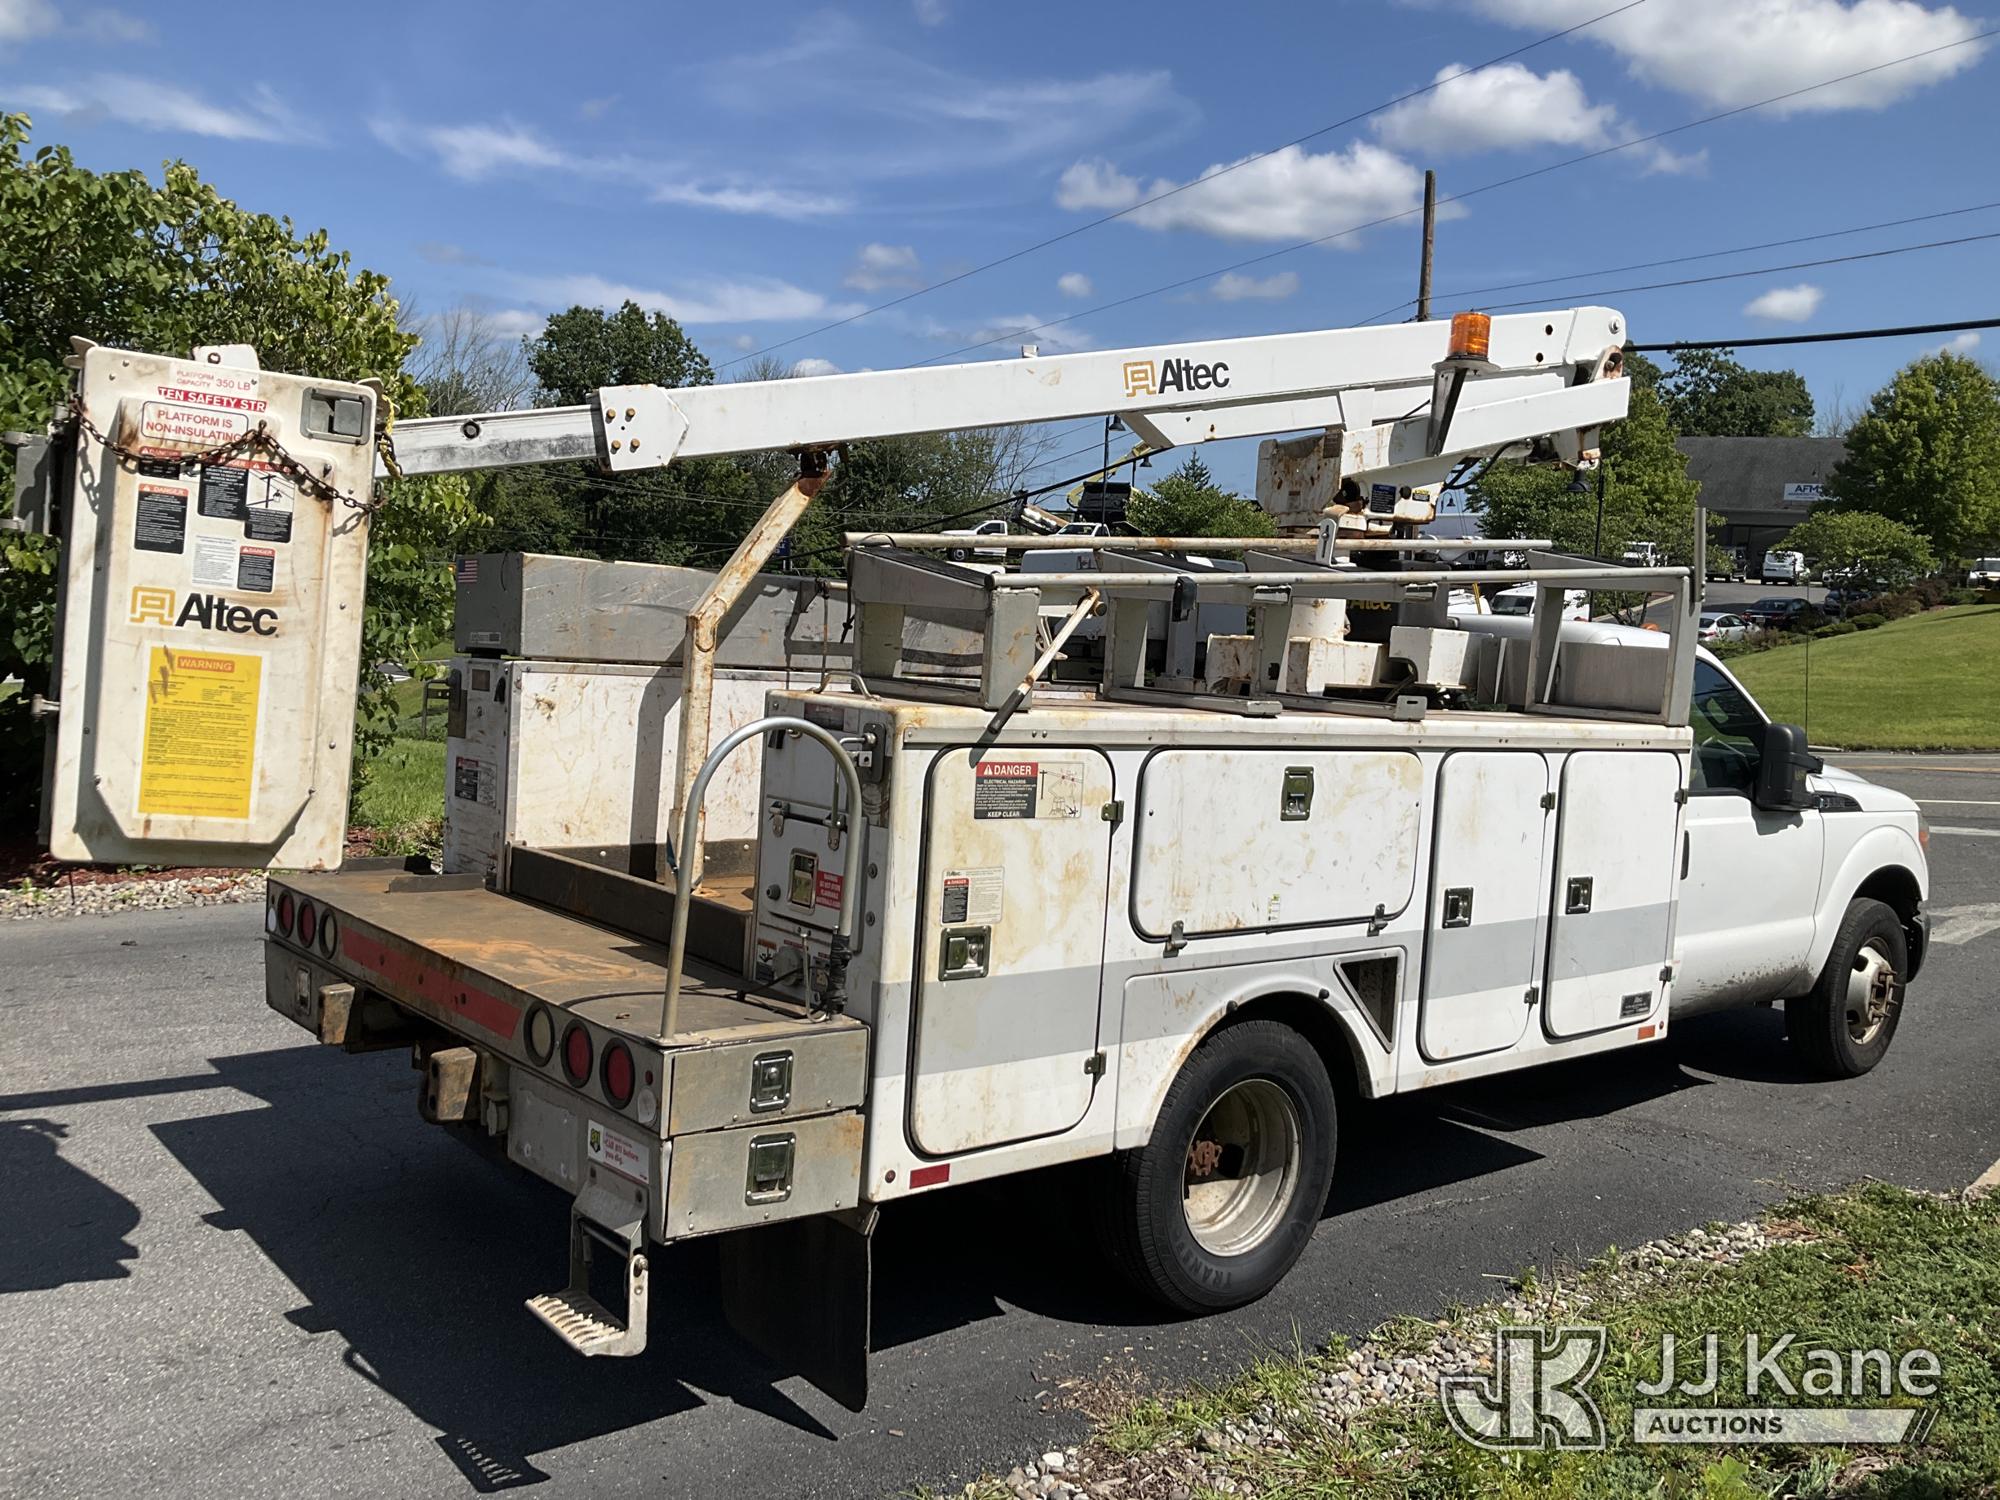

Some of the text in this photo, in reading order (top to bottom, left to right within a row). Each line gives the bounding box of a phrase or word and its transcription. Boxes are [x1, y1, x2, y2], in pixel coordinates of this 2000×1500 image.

[176, 370, 214, 380] PLATFORM
[1158, 358, 1230, 394] Altec
[176, 378, 211, 388] CAPACITY
[216, 378, 251, 391] 350 LB
[187, 391, 238, 408] SAFETY
[157, 409, 233, 429] PLATFORM IS
[145, 421, 241, 442] NON-INSULATING
[175, 592, 279, 636] Altec
[179, 657, 233, 672] WARNING
[993, 764, 1032, 776] DANGER
[1002, 810, 1020, 818] CLEAR
